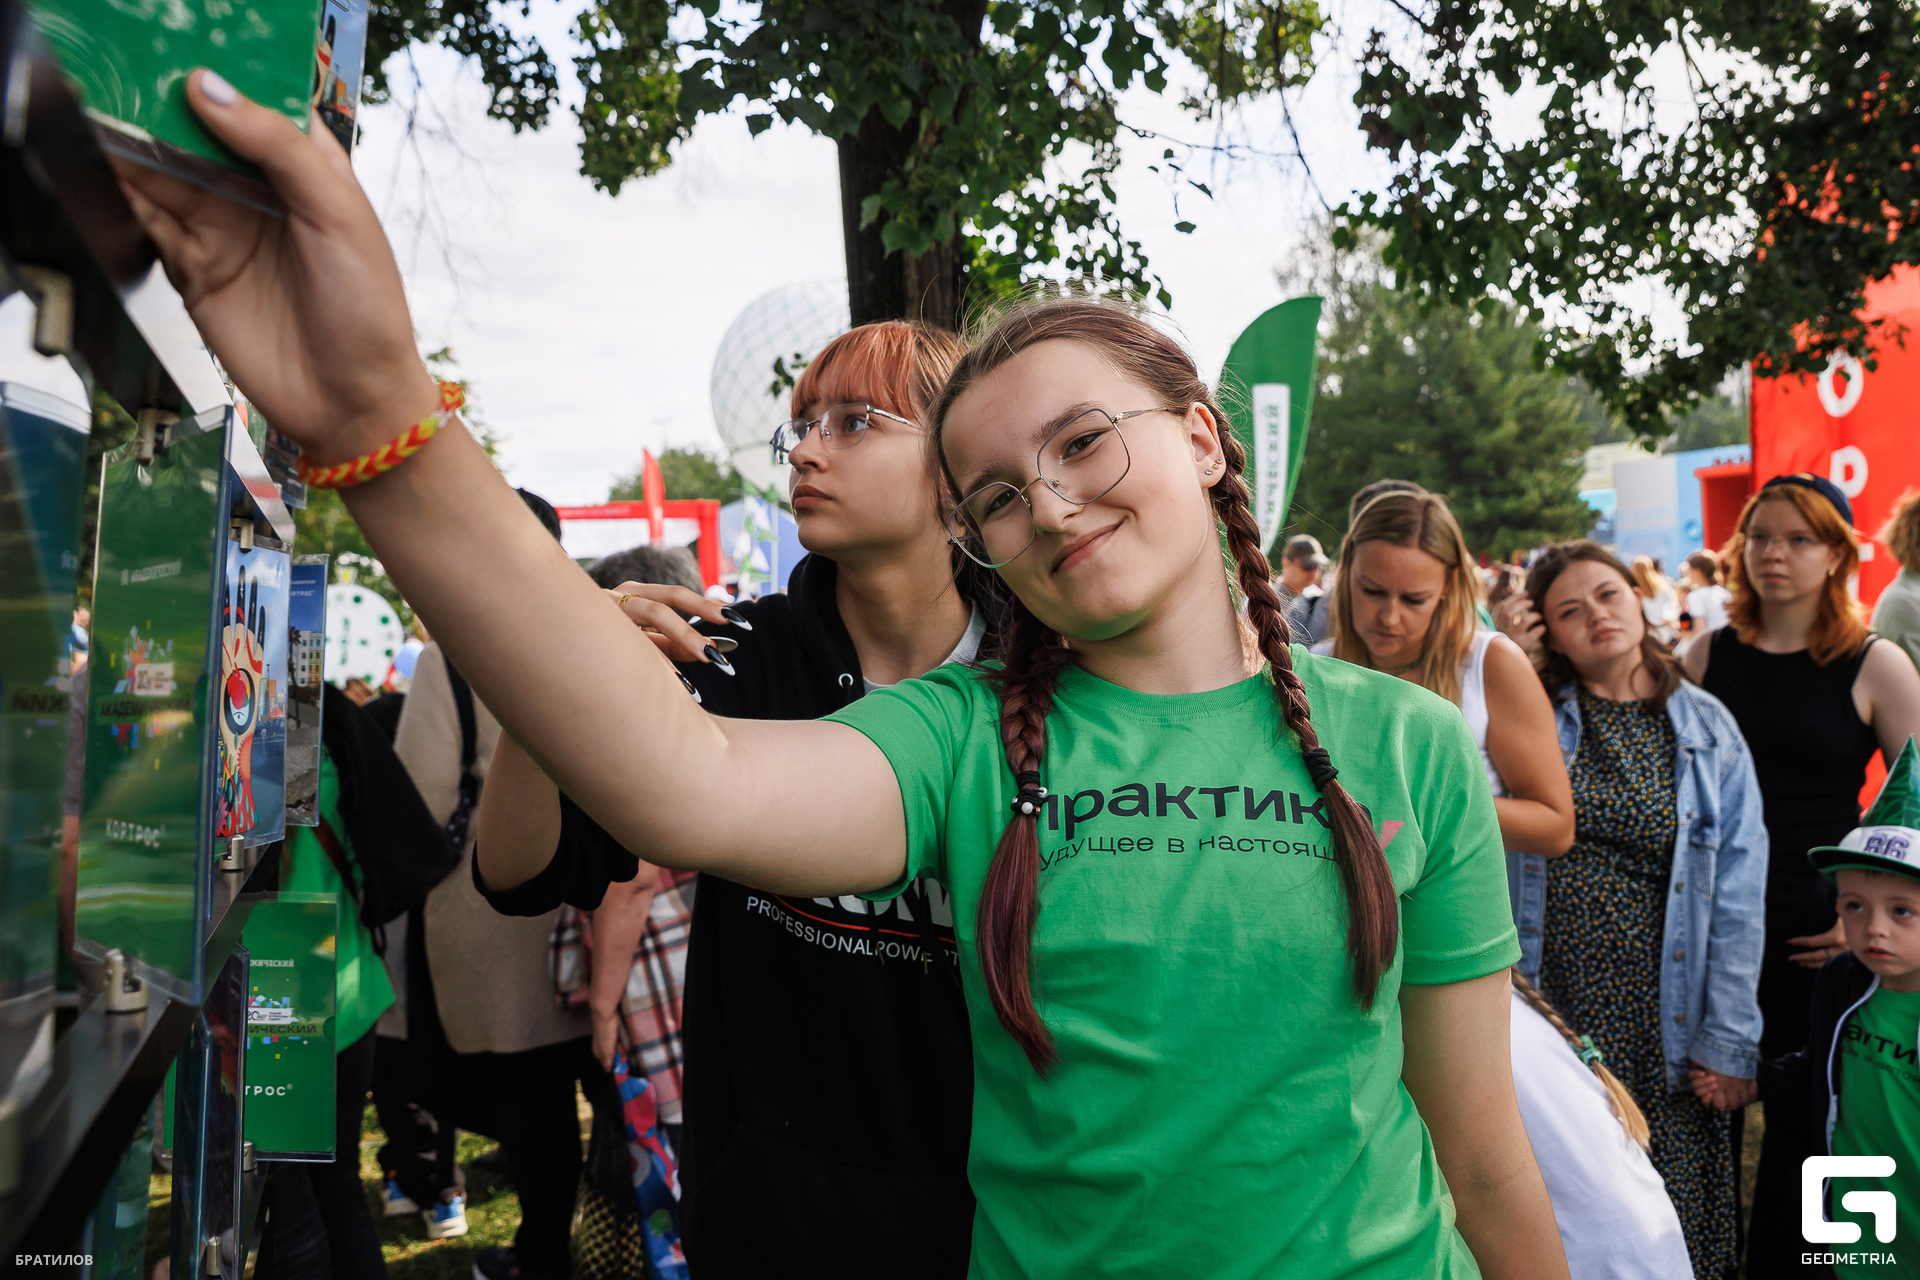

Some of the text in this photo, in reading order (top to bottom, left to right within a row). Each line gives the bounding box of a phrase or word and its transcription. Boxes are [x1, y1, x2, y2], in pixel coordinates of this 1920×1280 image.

[1040, 782, 1373, 842] рактик
[1040, 835, 1338, 872] удущее в настоящ
[746, 895, 874, 956] PROFESSIONAL
[874, 940, 949, 962] POWE
